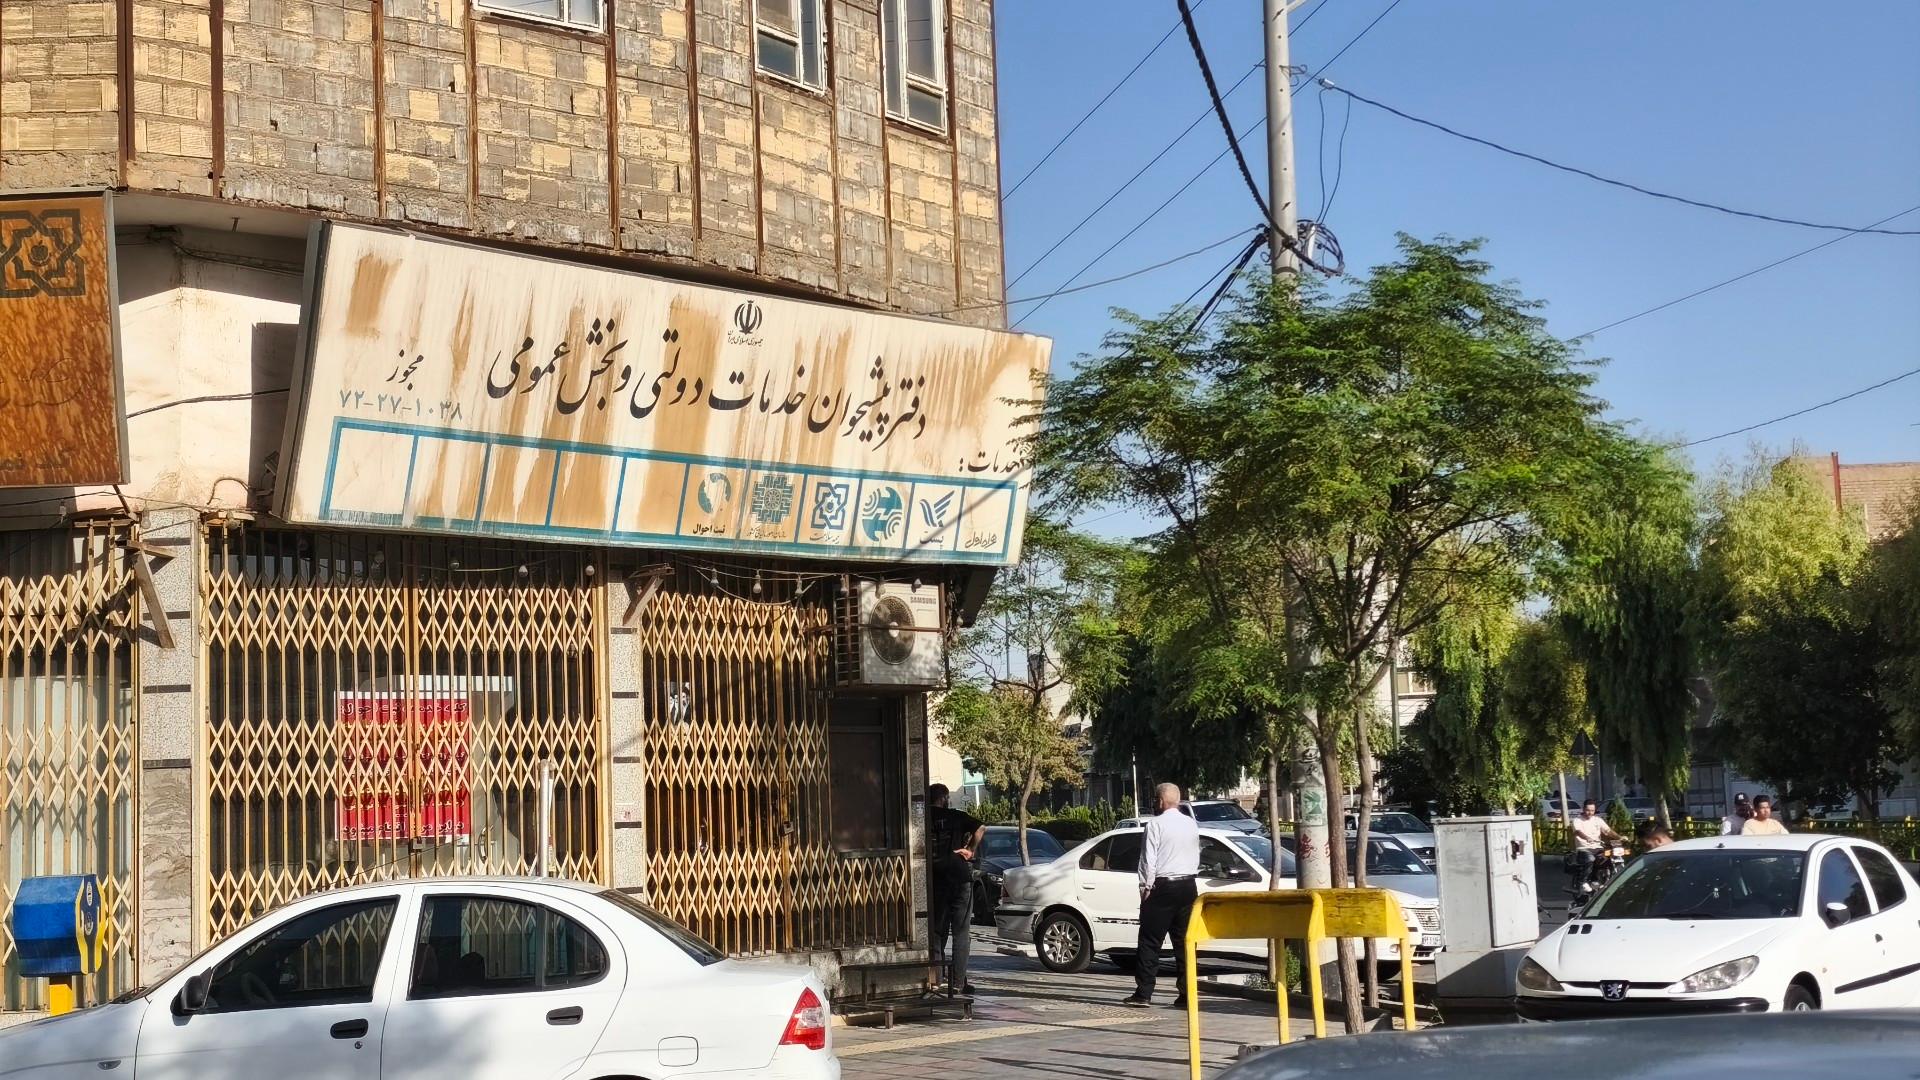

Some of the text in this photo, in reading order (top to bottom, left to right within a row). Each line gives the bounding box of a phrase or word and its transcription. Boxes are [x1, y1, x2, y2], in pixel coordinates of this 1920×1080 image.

[386, 349, 424, 391] مجوز
[487, 336, 571, 399] عمومی
[557, 317, 628, 415] بخش
[613, 365, 631, 393] و
[630, 328, 703, 419] دولتی
[709, 364, 806, 415] خدمات
[872, 375, 926, 452] دفتر
[692, 523, 713, 535] احوال
[919, 530, 944, 548] پست
[910, 596, 937, 605] SAMSUNG
